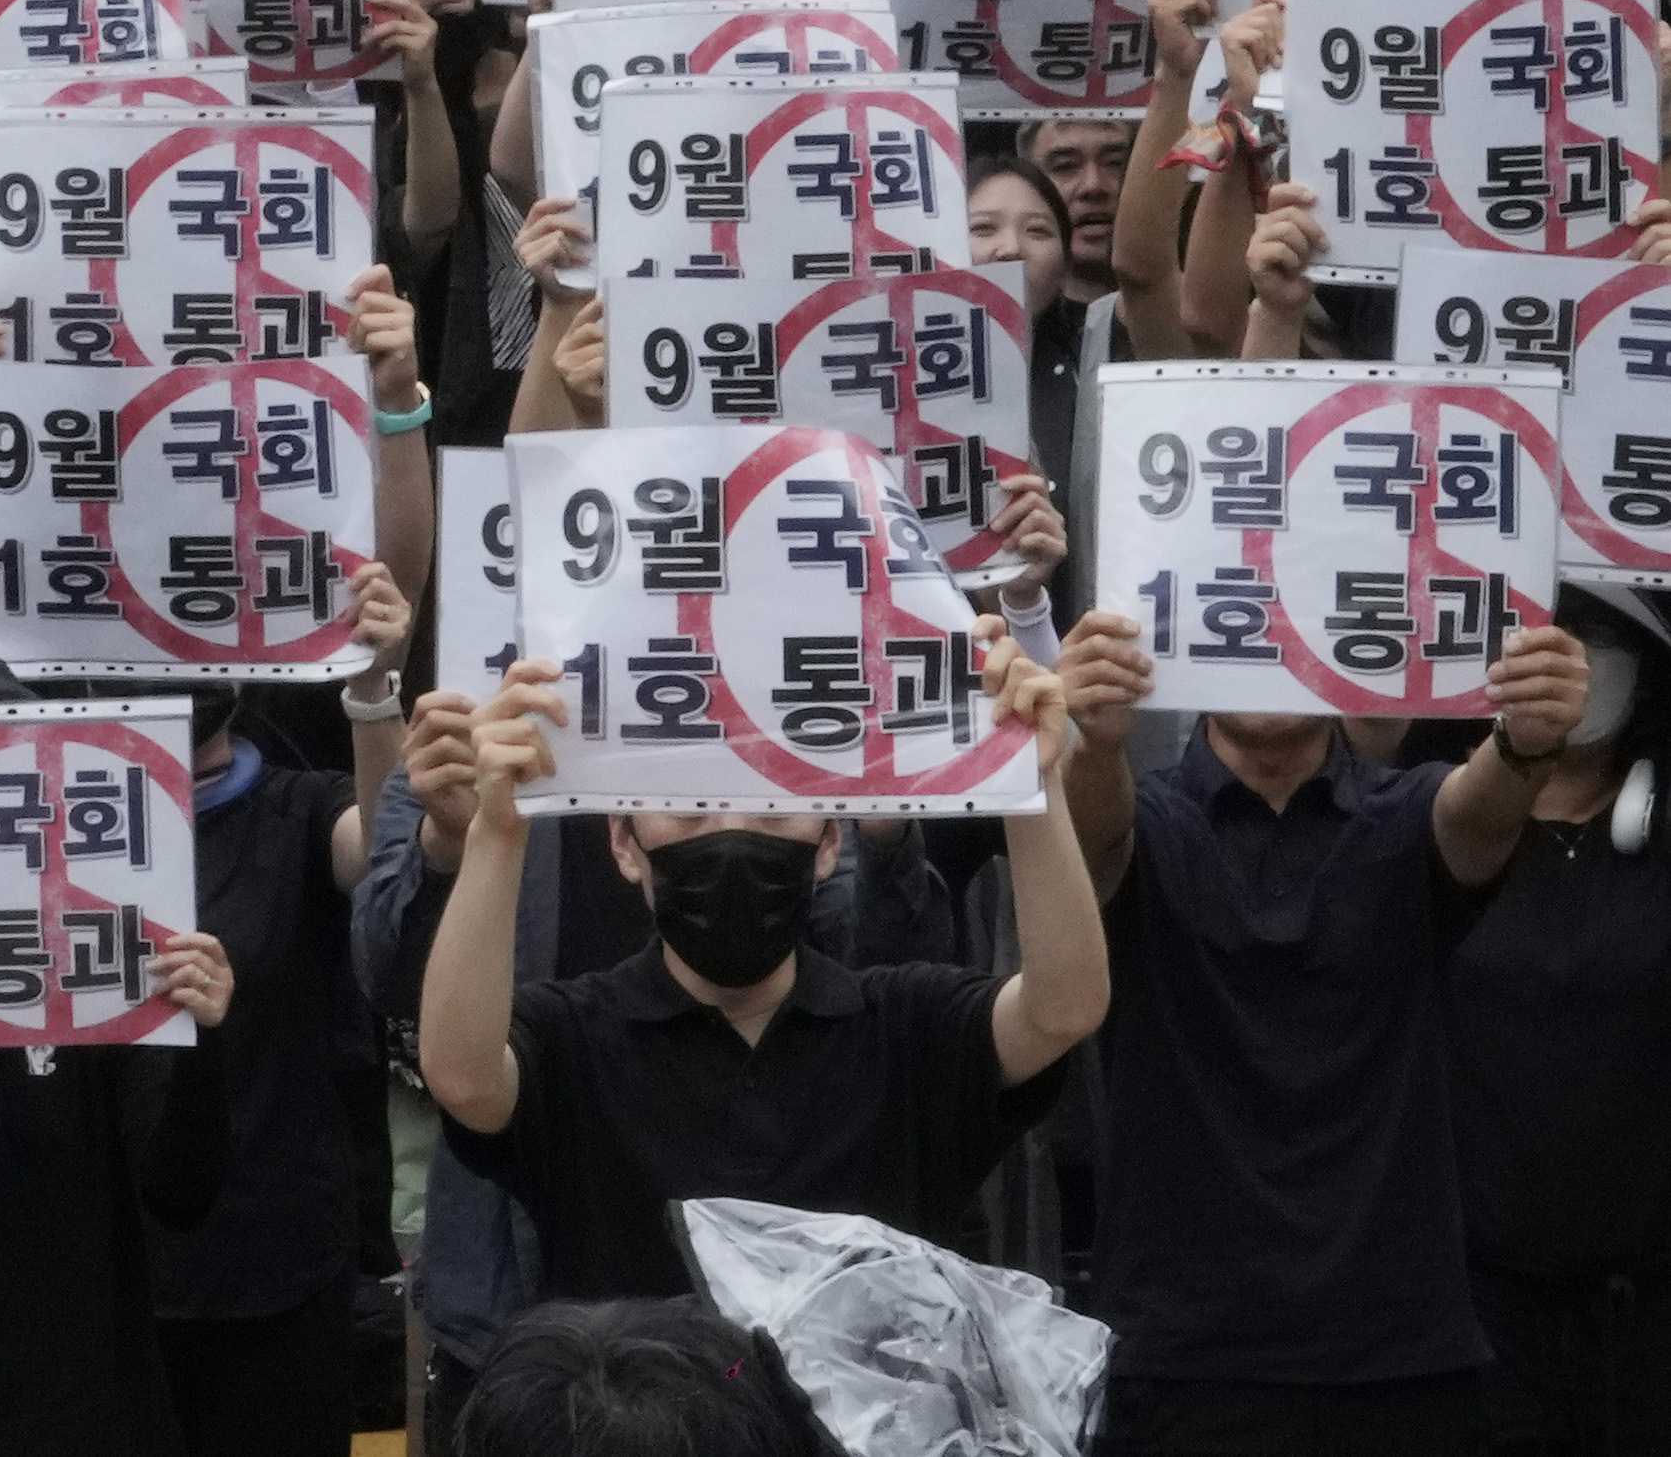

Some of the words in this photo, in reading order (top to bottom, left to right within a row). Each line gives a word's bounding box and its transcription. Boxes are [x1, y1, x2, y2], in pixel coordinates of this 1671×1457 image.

[901, 20, 1001, 82] 1호
[1031, 21, 1158, 82] 통과
[1319, 23, 1444, 112] 9월
[1481, 15, 1627, 109] 국회
[169, 166, 336, 260] 국회
[1321, 148, 1438, 226] 1호
[1477, 141, 1631, 230] 통과
[643, 324, 783, 418] 9월
[820, 309, 987, 409] 국회
[162, 399, 337, 498] 국회
[1135, 425, 1288, 526] 9월
[1332, 425, 1518, 534] 국회
[160, 532, 342, 623] 통과
[560, 476, 726, 591] 9월
[1137, 569, 1277, 661] 1호
[1323, 575, 1518, 672] 통과
[583, 636, 722, 743] 1호
[771, 630, 987, 751] 통과
